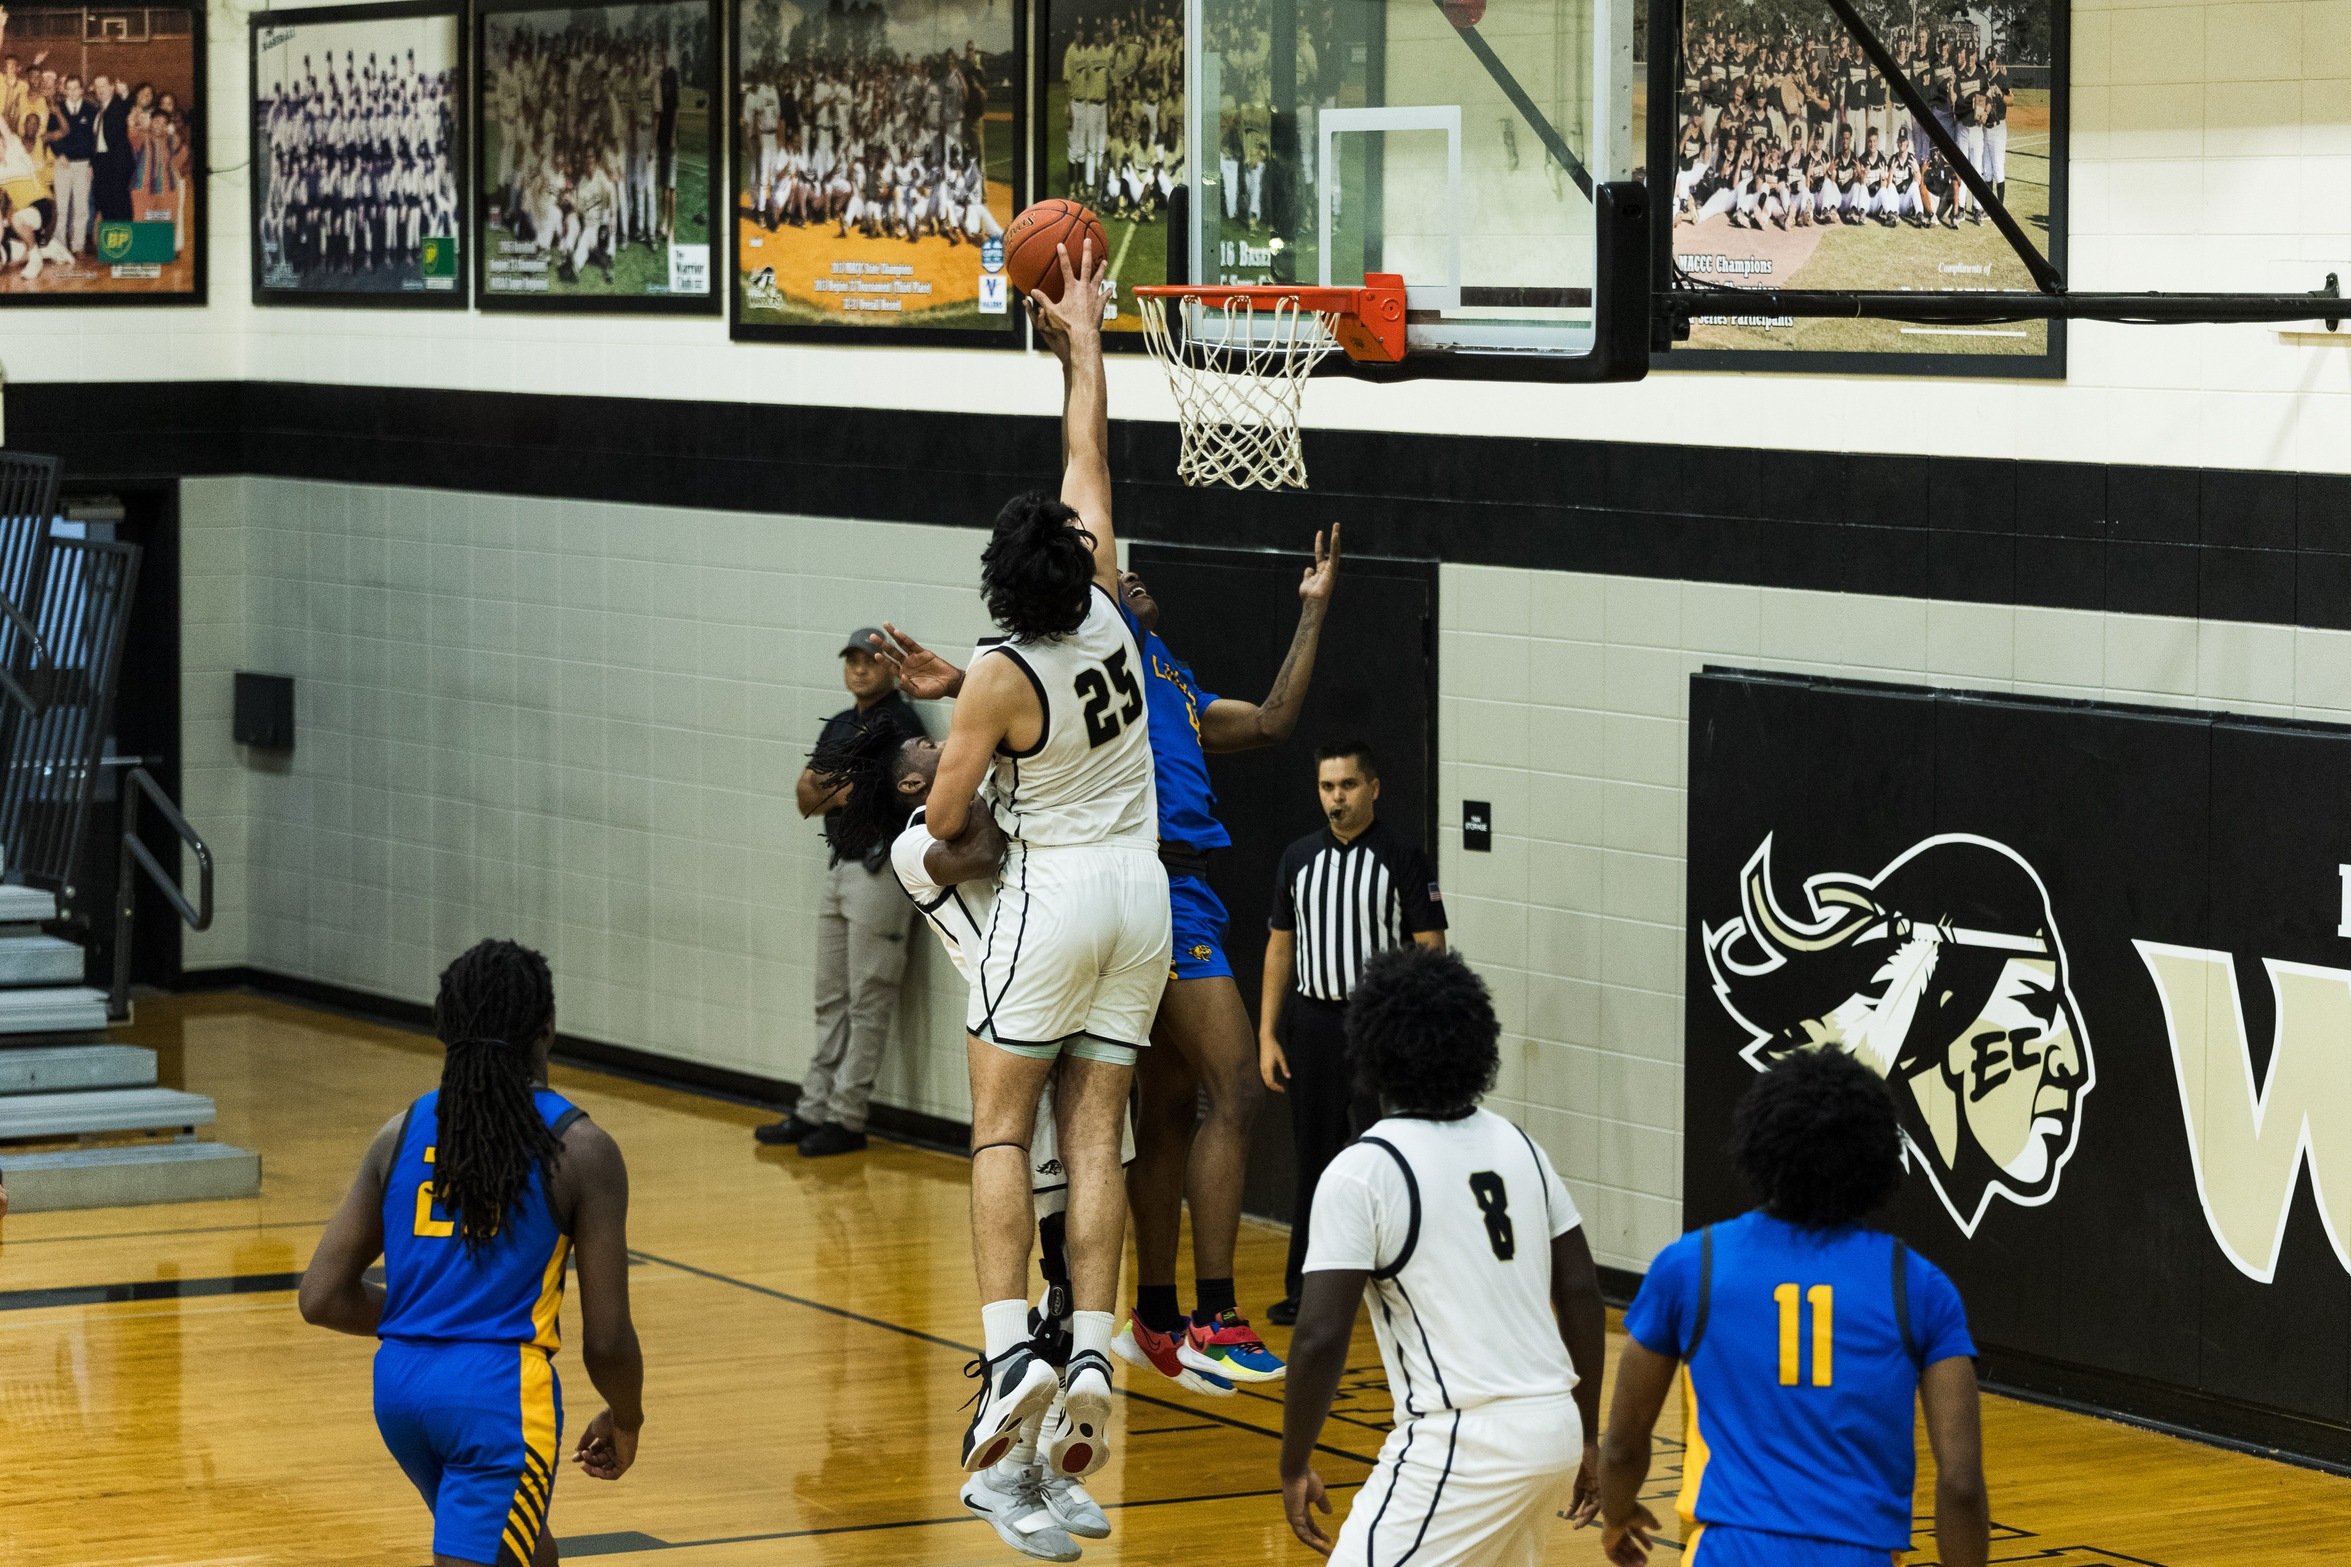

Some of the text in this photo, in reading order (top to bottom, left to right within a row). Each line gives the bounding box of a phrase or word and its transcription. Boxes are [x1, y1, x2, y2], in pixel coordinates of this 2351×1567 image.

[1678, 254, 1773, 278] MACCC Champions
[1938, 261, 1993, 277] Compliments of
[1074, 646, 1144, 749] 25
[1469, 1170, 1515, 1262] 8
[1773, 1283, 1834, 1388] 11
